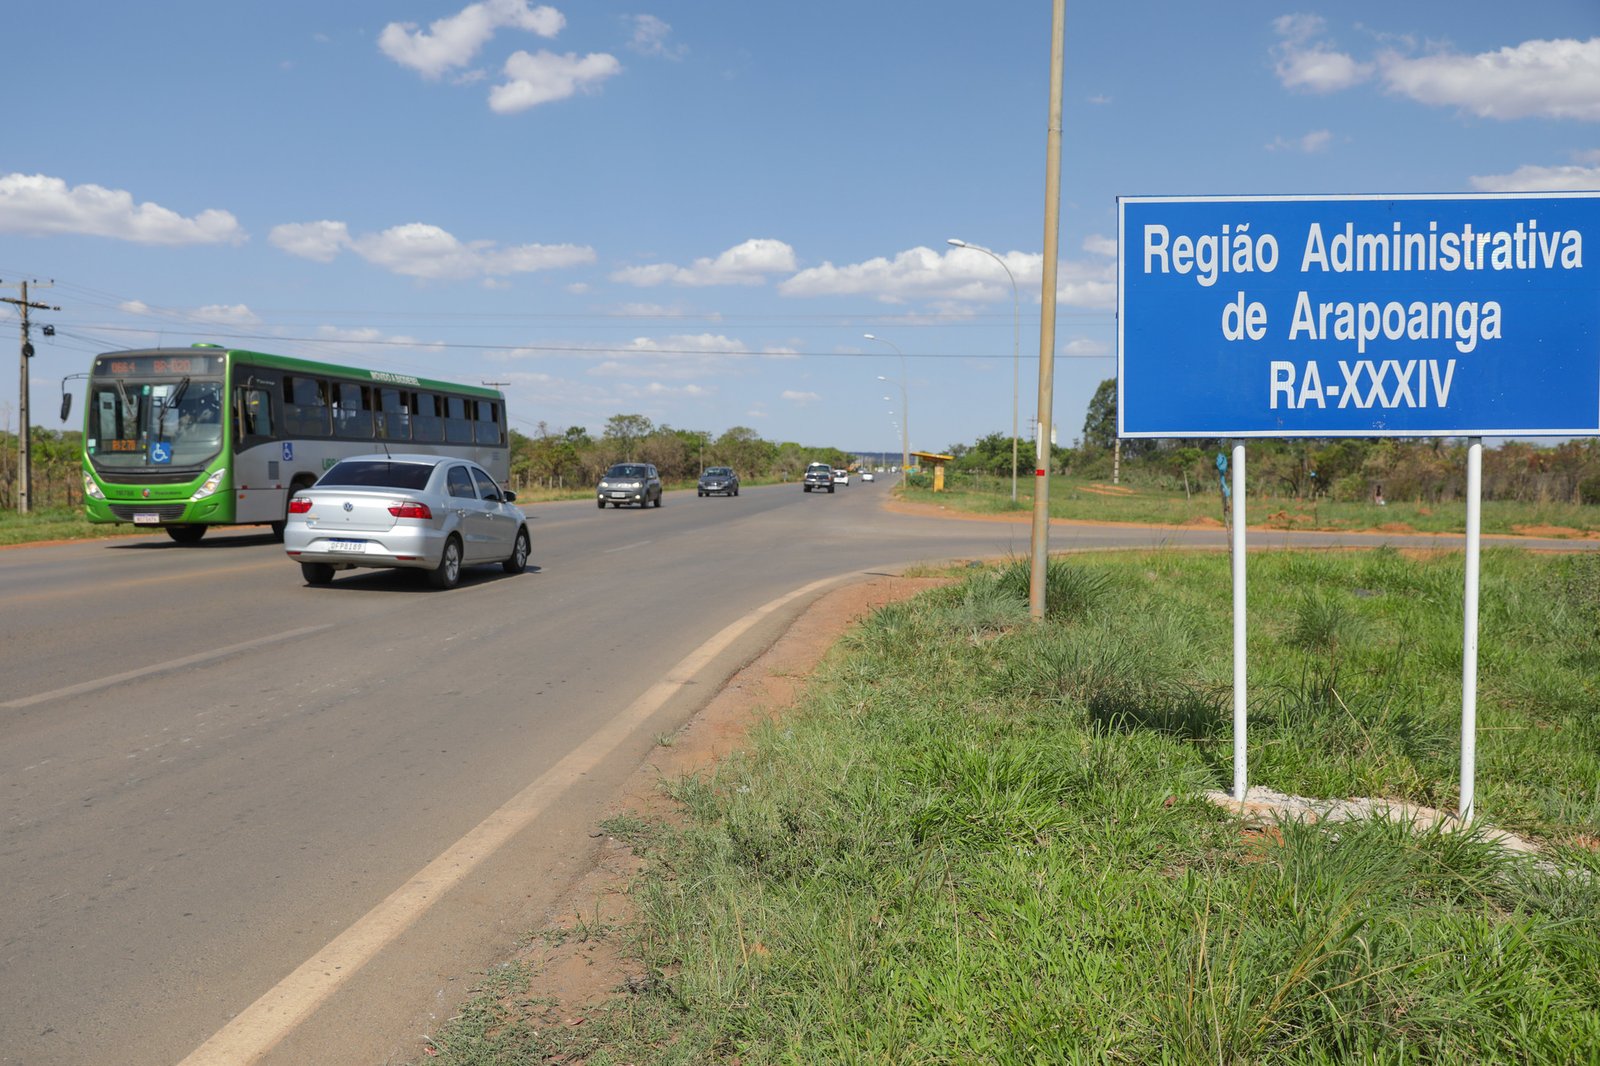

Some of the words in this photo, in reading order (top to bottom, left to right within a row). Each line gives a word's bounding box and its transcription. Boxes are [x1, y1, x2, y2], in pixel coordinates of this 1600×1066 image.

[1143, 222, 1279, 287] Região
[1300, 218, 1584, 274] Administrativa
[1221, 290, 1268, 341] de
[1288, 290, 1502, 354] Arapoanga
[1269, 358, 1456, 410] RA-XXXIV
